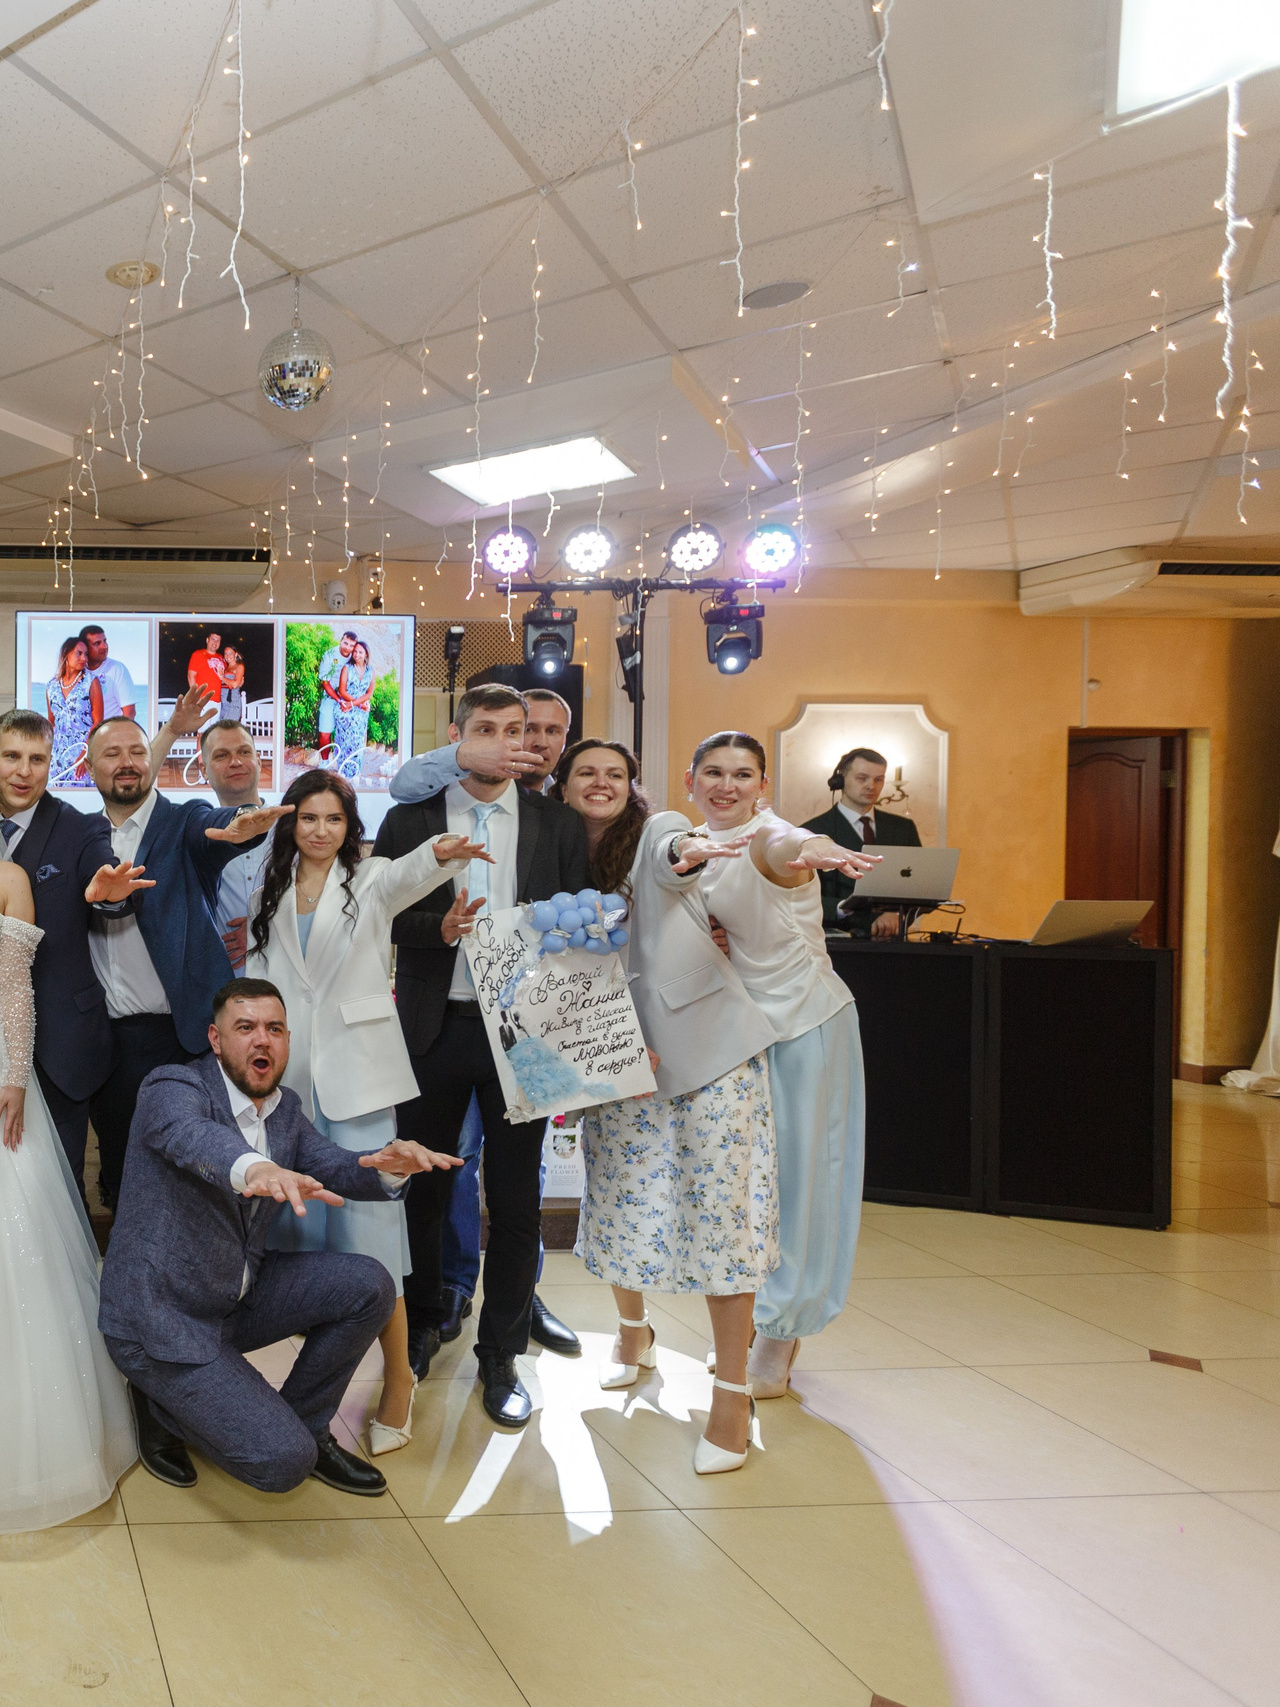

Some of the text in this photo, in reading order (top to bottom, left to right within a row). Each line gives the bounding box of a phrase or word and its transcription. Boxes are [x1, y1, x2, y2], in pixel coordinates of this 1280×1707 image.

[529, 965, 605, 1005] Валерий
[557, 988, 625, 1015] Жанна
[540, 1016, 583, 1038] Живите
[594, 1005, 632, 1021] блеском
[587, 1015, 627, 1032] глазах
[610, 1028, 637, 1043] душе
[597, 1047, 645, 1076] сердце!
